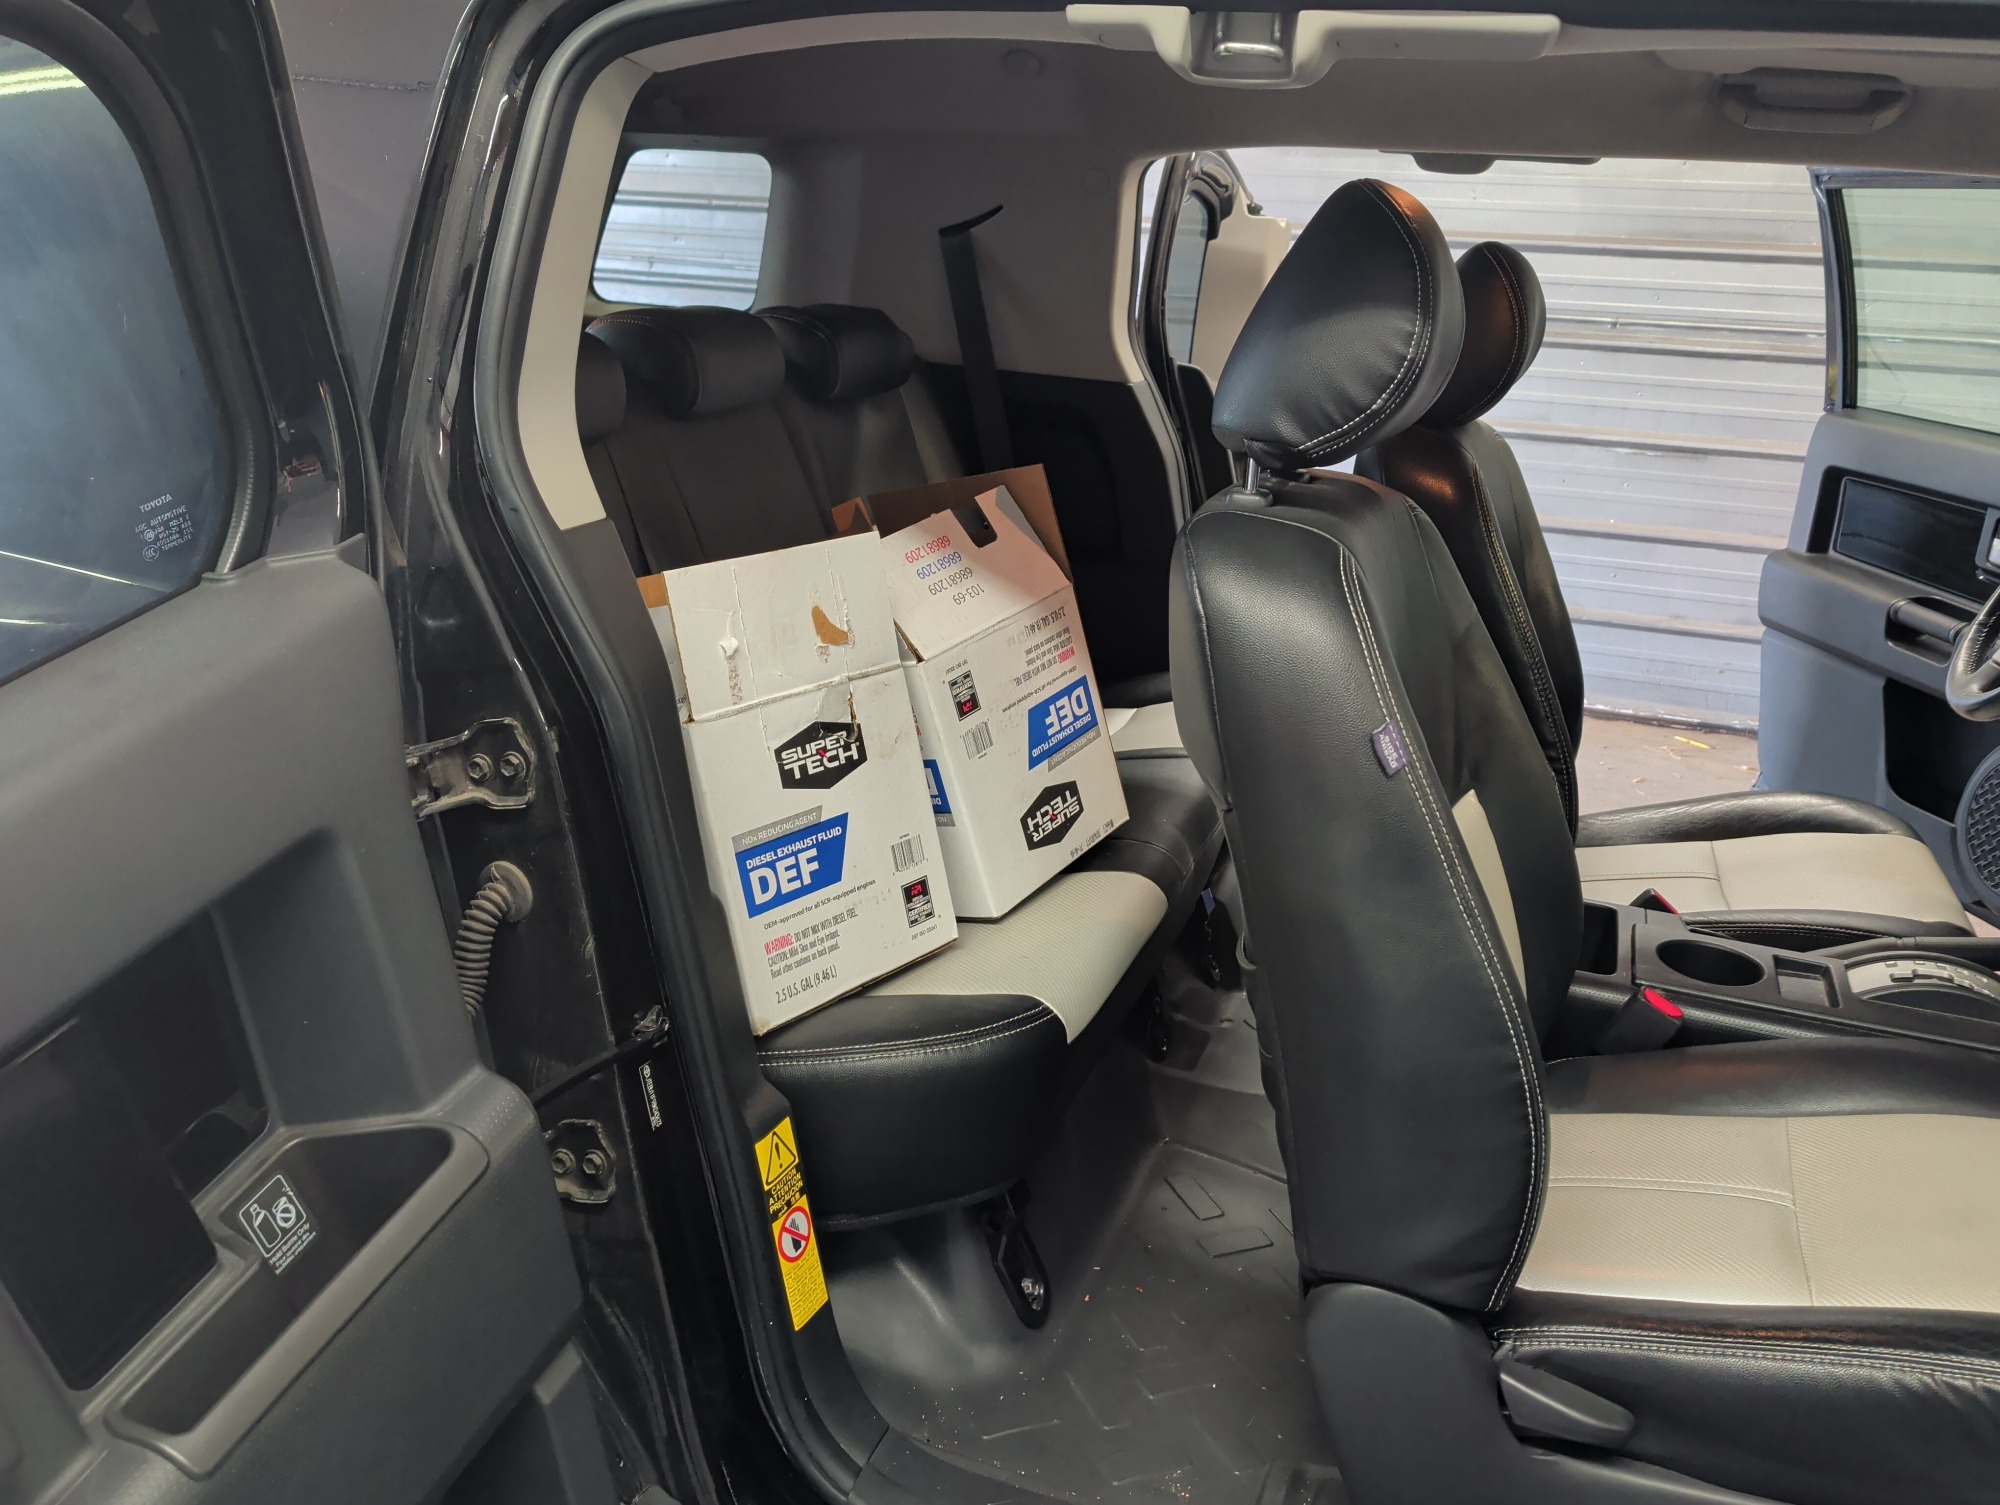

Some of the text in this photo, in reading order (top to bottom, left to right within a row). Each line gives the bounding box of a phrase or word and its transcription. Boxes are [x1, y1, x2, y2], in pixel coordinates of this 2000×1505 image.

[139, 494, 172, 512] TOYOTA
[150, 505, 187, 526] AUTOMOTIVE
[904, 536, 950, 564] 68681209
[916, 552, 962, 580] 68681209
[928, 567, 972, 596] 68681209
[952, 584, 984, 605] 103-69
[1045, 686, 1088, 736] DEF
[781, 730, 847, 764] SUPER
[1032, 713, 1092, 758] DIESEL EXHAUST FLUID
[1066, 738, 1086, 755] REDUCING
[784, 743, 859, 780] TECH
[1051, 750, 1066, 766] AGENT
[742, 812, 818, 846] NOx REDUCING AGENT
[1027, 790, 1078, 832] TECH
[1032, 801, 1080, 842] SUPER
[746, 826, 842, 870] DIESEL EXHAUST FLUID
[748, 848, 820, 906] DEF
[764, 908, 805, 930] OEM-approved
[806, 905, 814, 913] for
[820, 886, 857, 906] SCR-equipped
[857, 880, 876, 892] engines
[764, 908, 858, 956] WARNING: DO NOT MIX WITH DIESEL FUEL.
[768, 951, 789, 968] CAUTION:
[789, 948, 798, 958] Mild
[799, 943, 808, 954] Skin
[825, 929, 840, 942] Irritant.
[770, 940, 840, 980] Read other cautions on back panel.
[776, 964, 838, 1004] 2.5 U.S. GAL (9.46 L)
[770, 1172, 802, 1206] ATTENTION
[772, 1167, 797, 1194] CAUTION
[270, 1250, 282, 1264] Hold
[297, 1222, 310, 1236] Only
